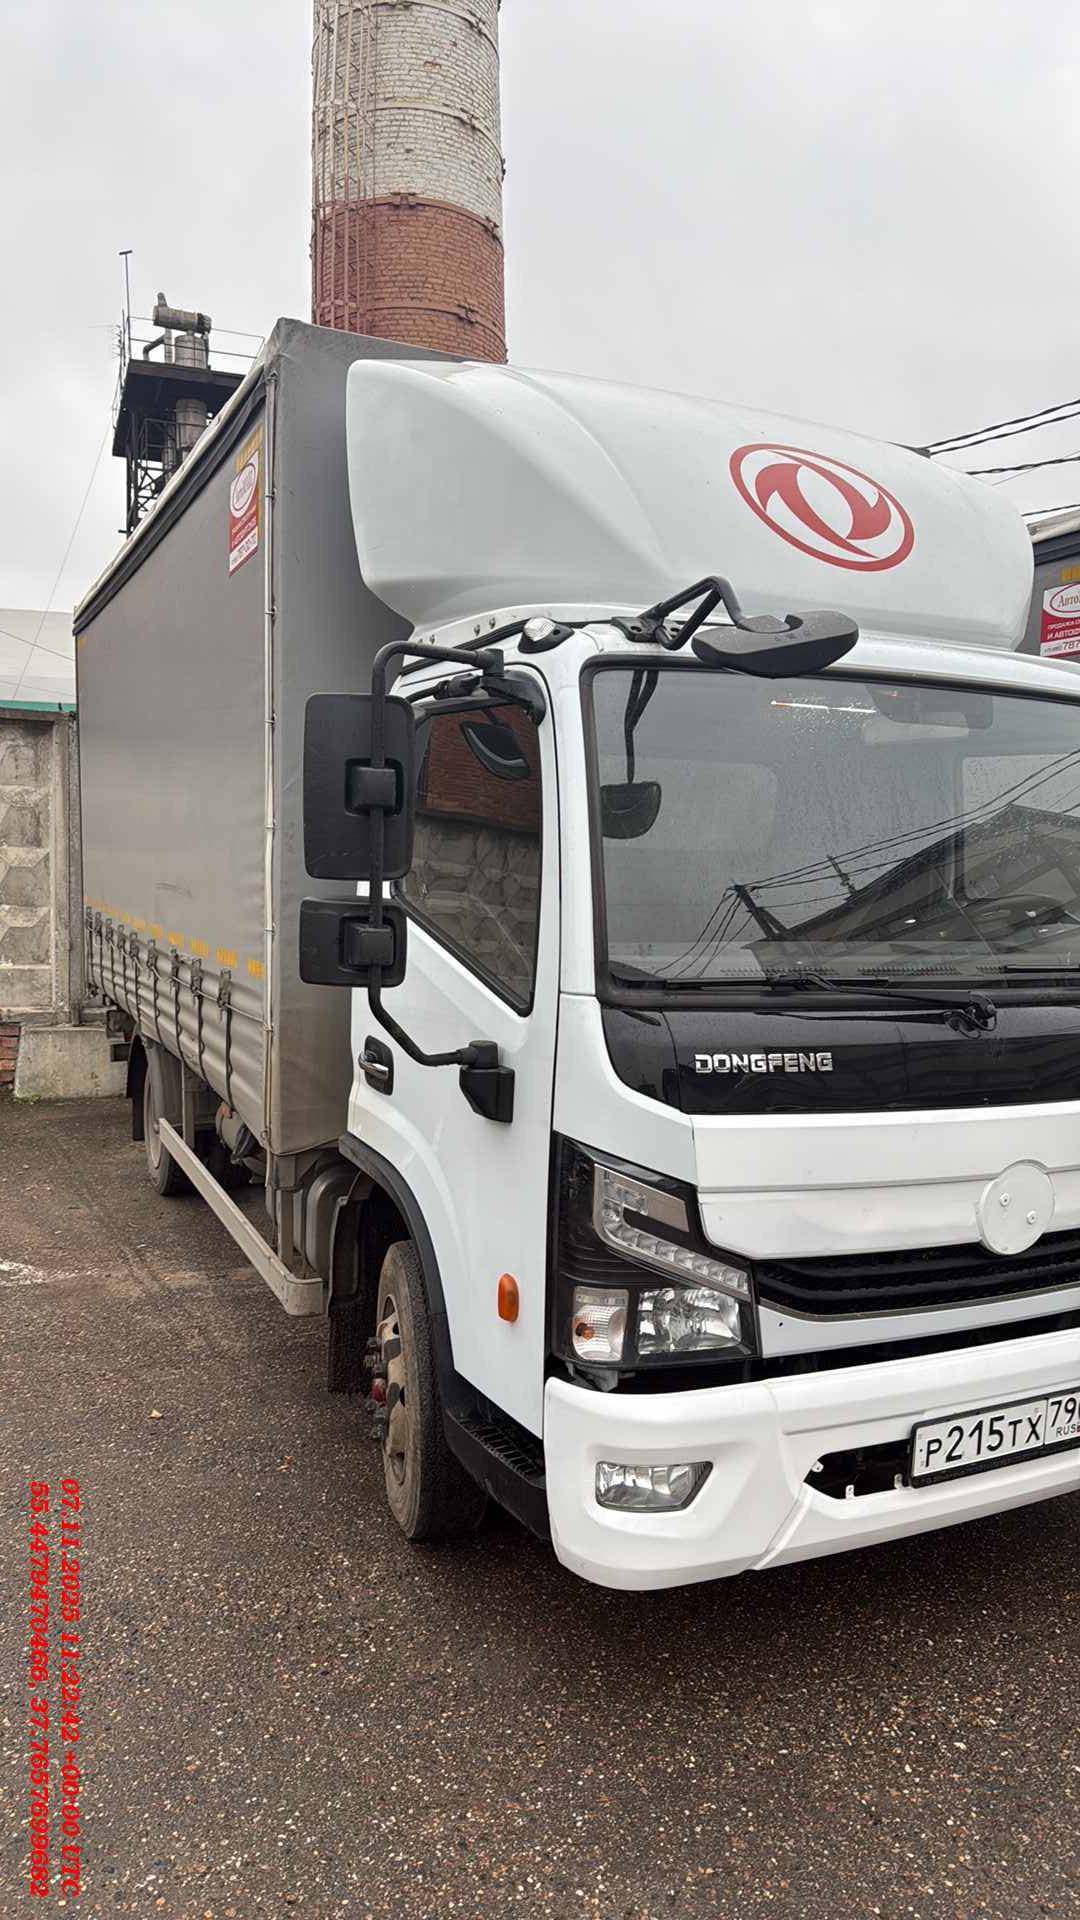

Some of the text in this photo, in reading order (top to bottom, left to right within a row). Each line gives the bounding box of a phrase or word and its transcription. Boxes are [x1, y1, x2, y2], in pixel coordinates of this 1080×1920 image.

[1057, 595, 1080, 607] Авто
[694, 1052, 833, 1073] DONGFENG
[1056, 1424, 1076, 1437] RUS
